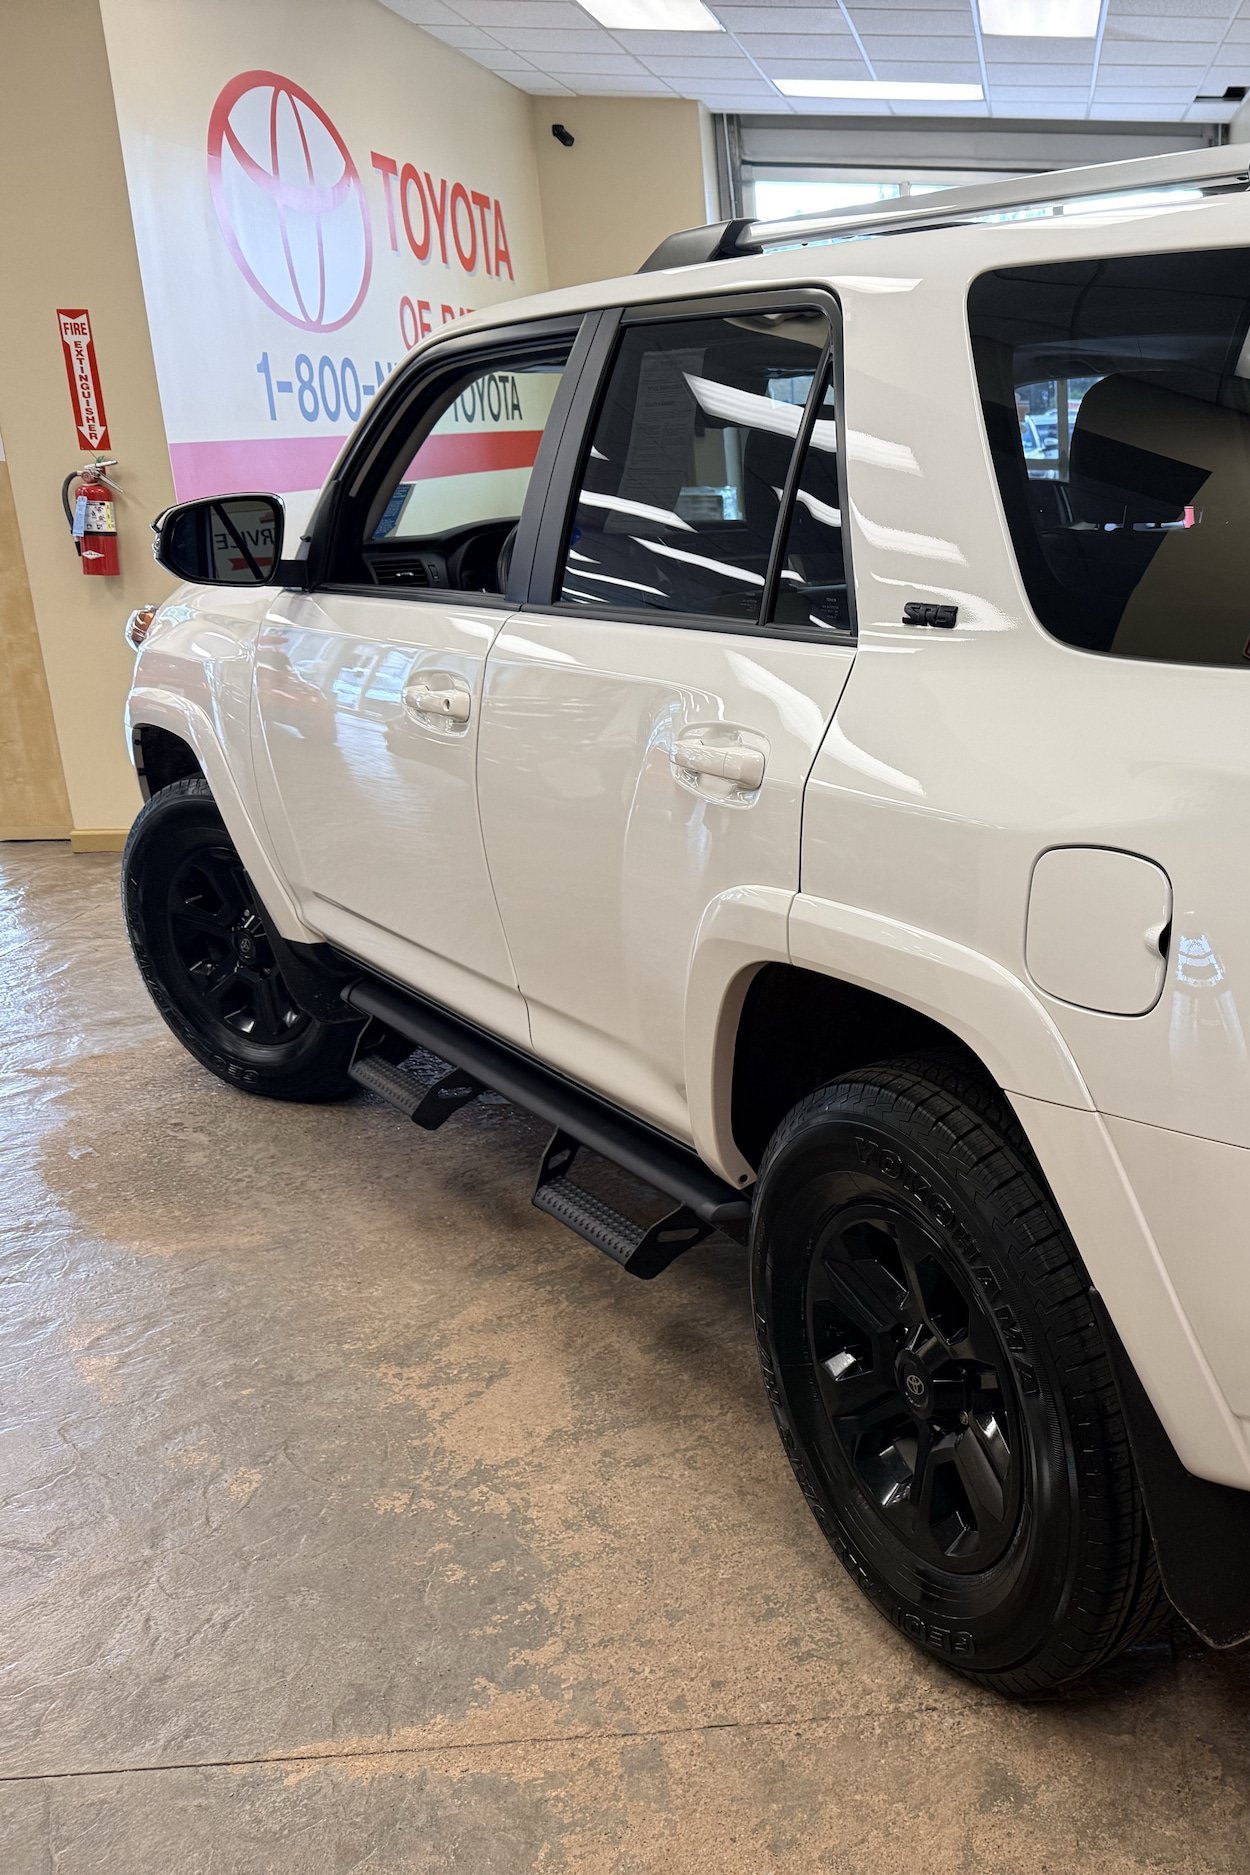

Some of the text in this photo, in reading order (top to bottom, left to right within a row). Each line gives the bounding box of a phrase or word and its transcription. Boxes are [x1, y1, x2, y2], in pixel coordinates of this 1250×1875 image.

[370, 151, 514, 282] TOYOTA
[63, 322, 87, 336] FIRE
[400, 295, 432, 351] OF
[73, 340, 99, 440] EXTINGUISHER
[256, 351, 397, 422] 1-800-
[902, 602, 958, 628] SR5
[854, 1135, 1041, 1399] YOKOHAMA
